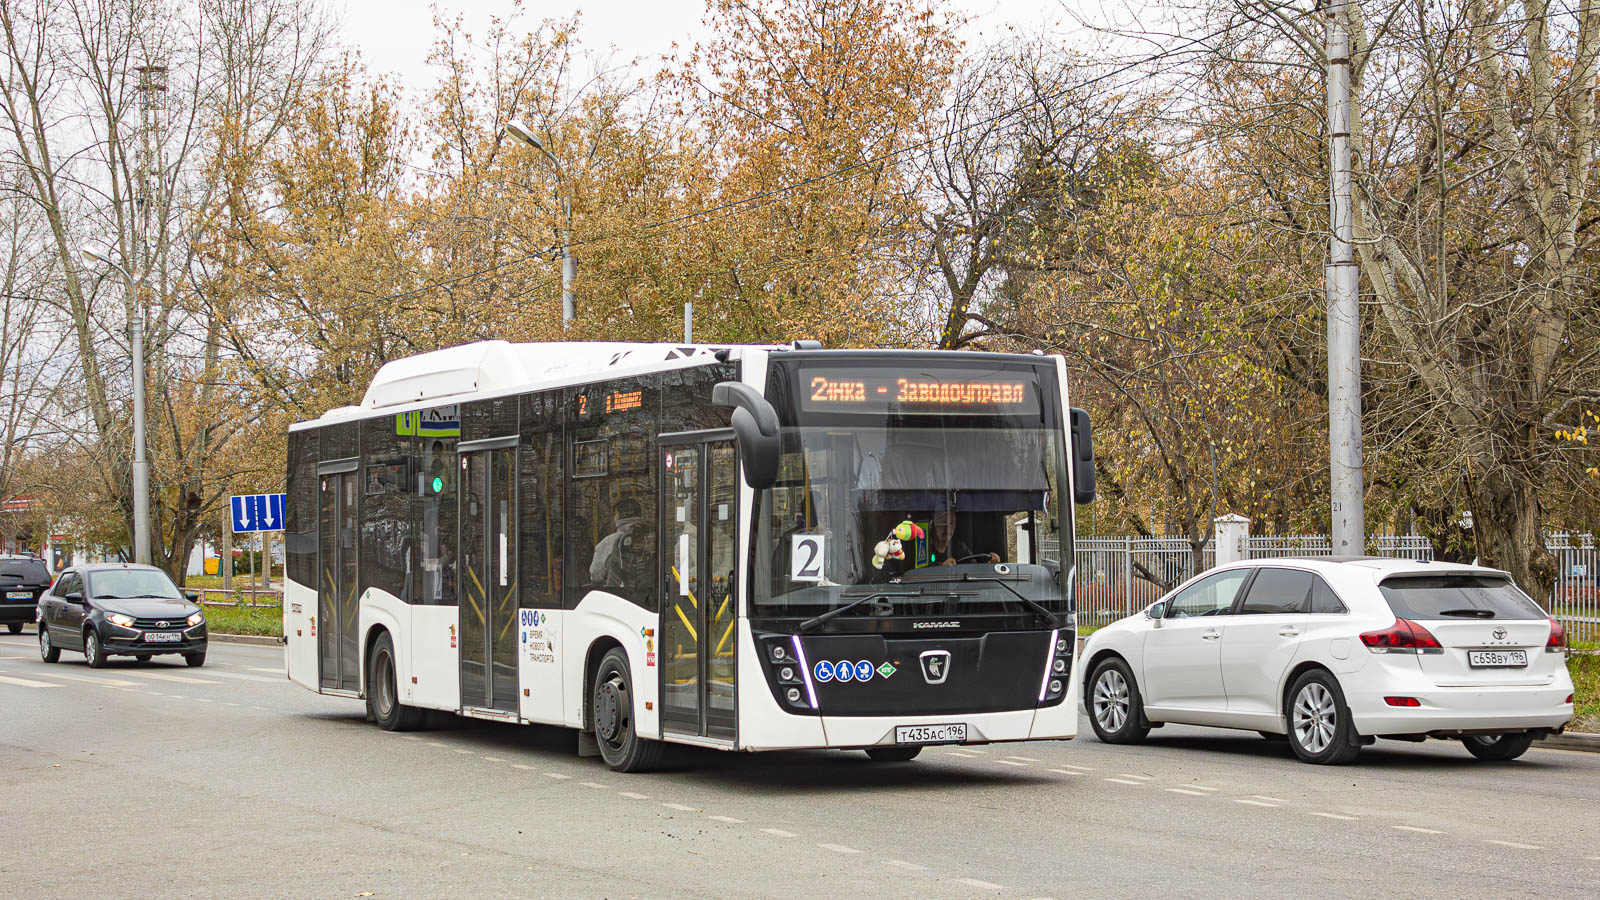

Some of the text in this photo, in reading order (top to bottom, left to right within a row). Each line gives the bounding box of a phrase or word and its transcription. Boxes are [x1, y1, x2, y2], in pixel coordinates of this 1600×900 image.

[896, 378, 1024, 404] Заводоуправл
[578, 395, 587, 414] 2
[1333, 501, 1342, 511] 21
[797, 539, 821, 577] 2
[1473, 652, 1508, 664] С658ВУ
[901, 725, 964, 742] Т435АС 196
